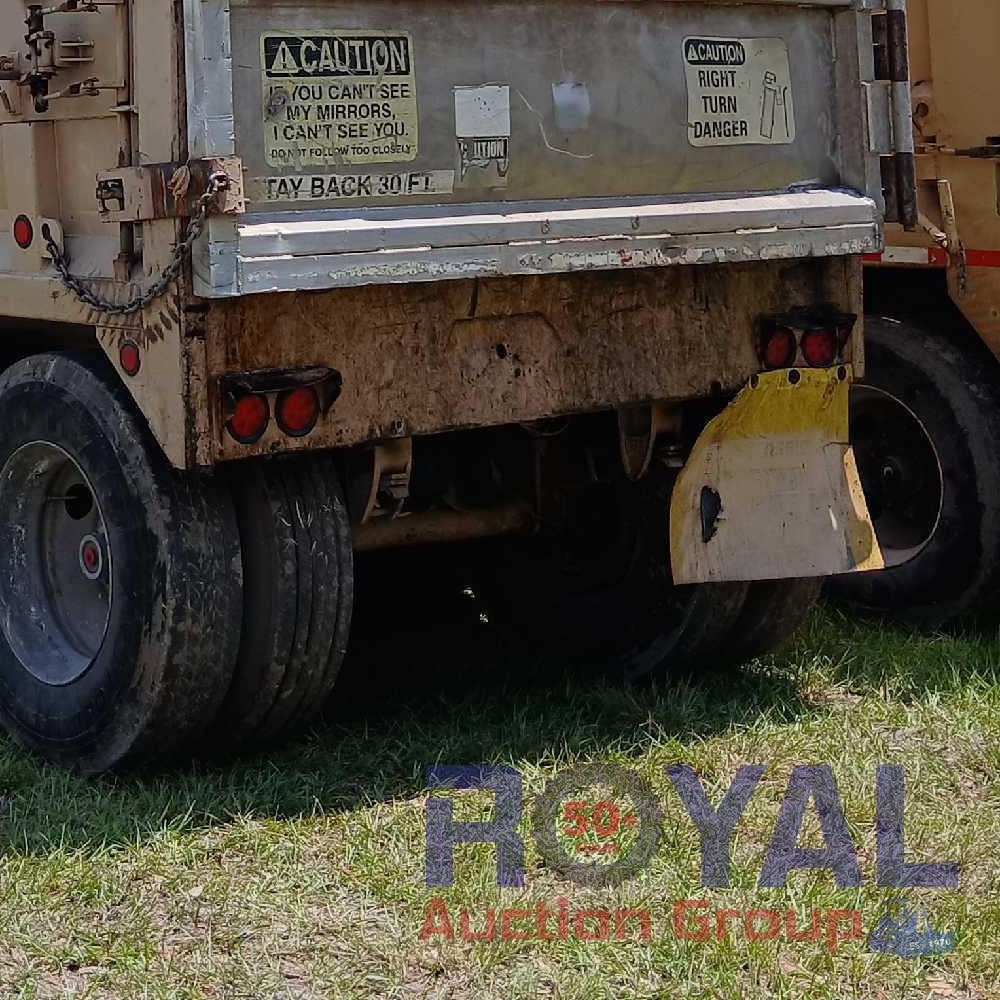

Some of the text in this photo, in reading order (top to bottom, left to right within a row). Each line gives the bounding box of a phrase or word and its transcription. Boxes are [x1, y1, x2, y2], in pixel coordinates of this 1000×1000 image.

[300, 39, 407, 75] CAUTION
[697, 43, 744, 63] CAUTION
[698, 70, 737, 88] RIGHT
[291, 85, 322, 101] YOU
[328, 85, 375, 100] CAN'T
[380, 83, 410, 99] SEE
[286, 103, 396, 121] MY MIRRORS,
[702, 96, 737, 113] TURN
[273, 122, 409, 140] I CAN'T SEE YOU.
[693, 120, 748, 138] DANGER
[352, 146, 371, 155] TOO
[460, 141, 505, 159] CUTION
[311, 175, 372, 198] BACK
[377, 174, 401, 194] 30
